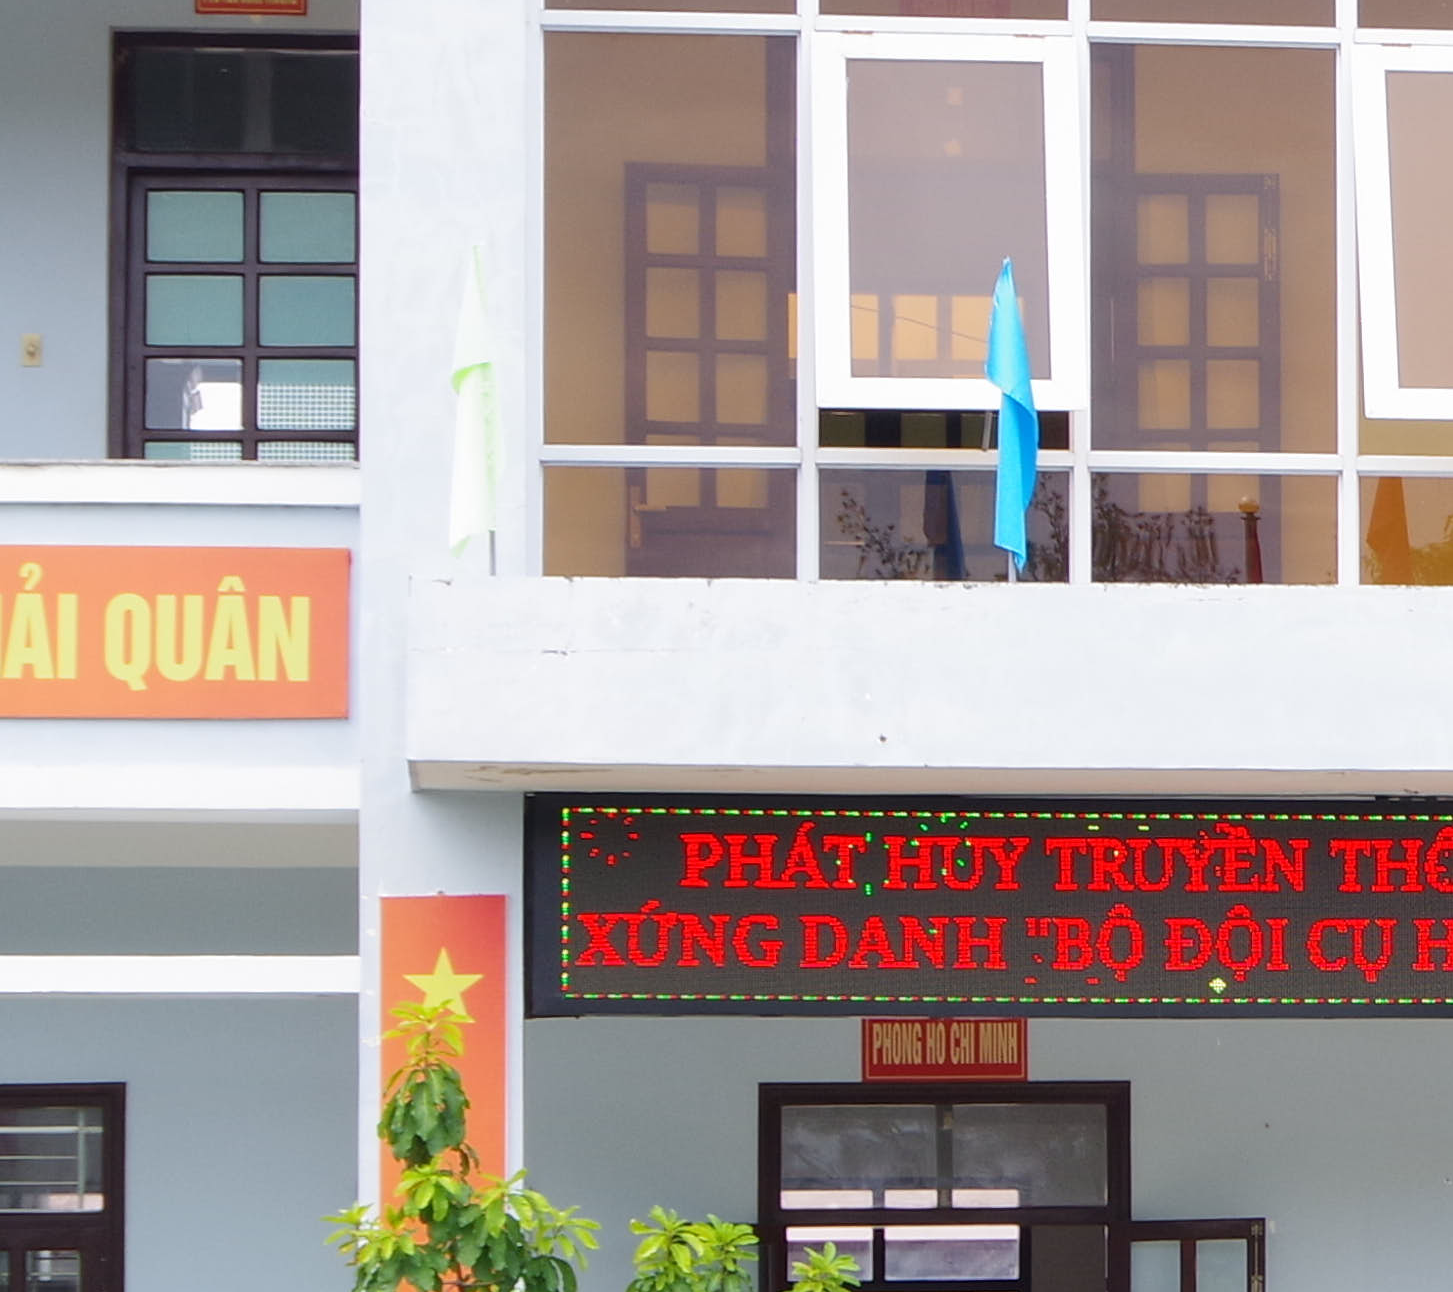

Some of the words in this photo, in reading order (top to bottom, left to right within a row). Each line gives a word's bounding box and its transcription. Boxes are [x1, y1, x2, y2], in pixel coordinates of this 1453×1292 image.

[0, 562, 78, 679] ẢI
[104, 575, 310, 691] QUÂN
[679, 821, 867, 890] PHÁT
[883, 835, 1030, 890] HUY
[1045, 823, 1310, 892] TRUYỀN
[575, 901, 783, 967] XỨNG
[799, 915, 1007, 969] DANH
[1164, 904, 1291, 981] ĐỘI
[1307, 917, 1397, 982] CỤ
[979, 1022, 1018, 1064] MINH
